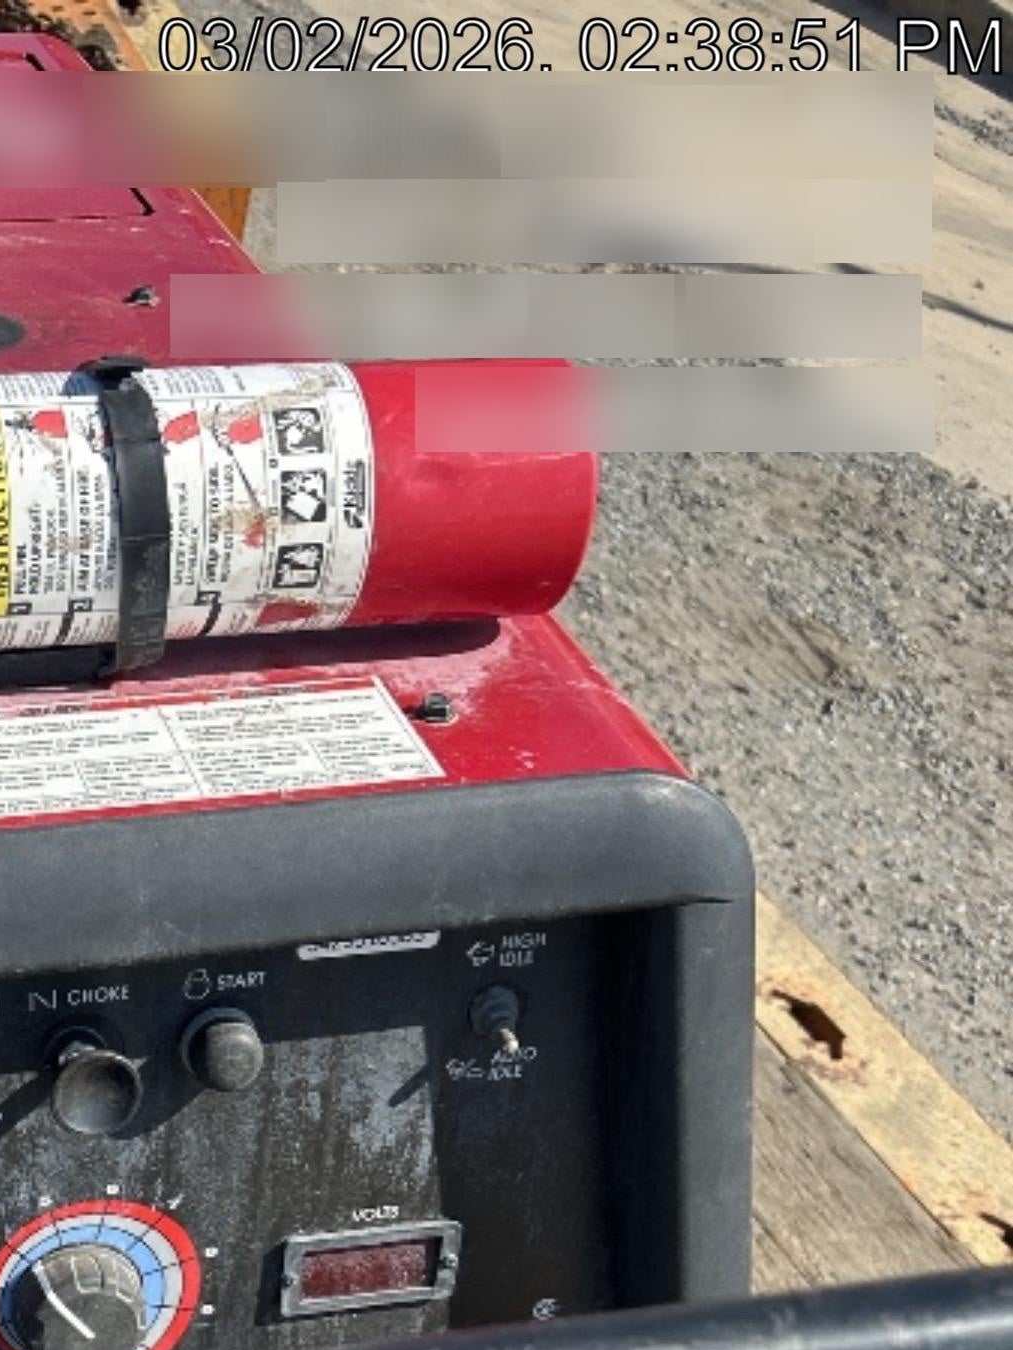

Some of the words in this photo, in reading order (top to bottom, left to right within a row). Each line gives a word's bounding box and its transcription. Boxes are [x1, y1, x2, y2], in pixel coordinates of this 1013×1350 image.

[217, 972, 266, 989] START
[67, 987, 129, 1006] CHOKE
[352, 1204, 400, 1222] VOLTS
